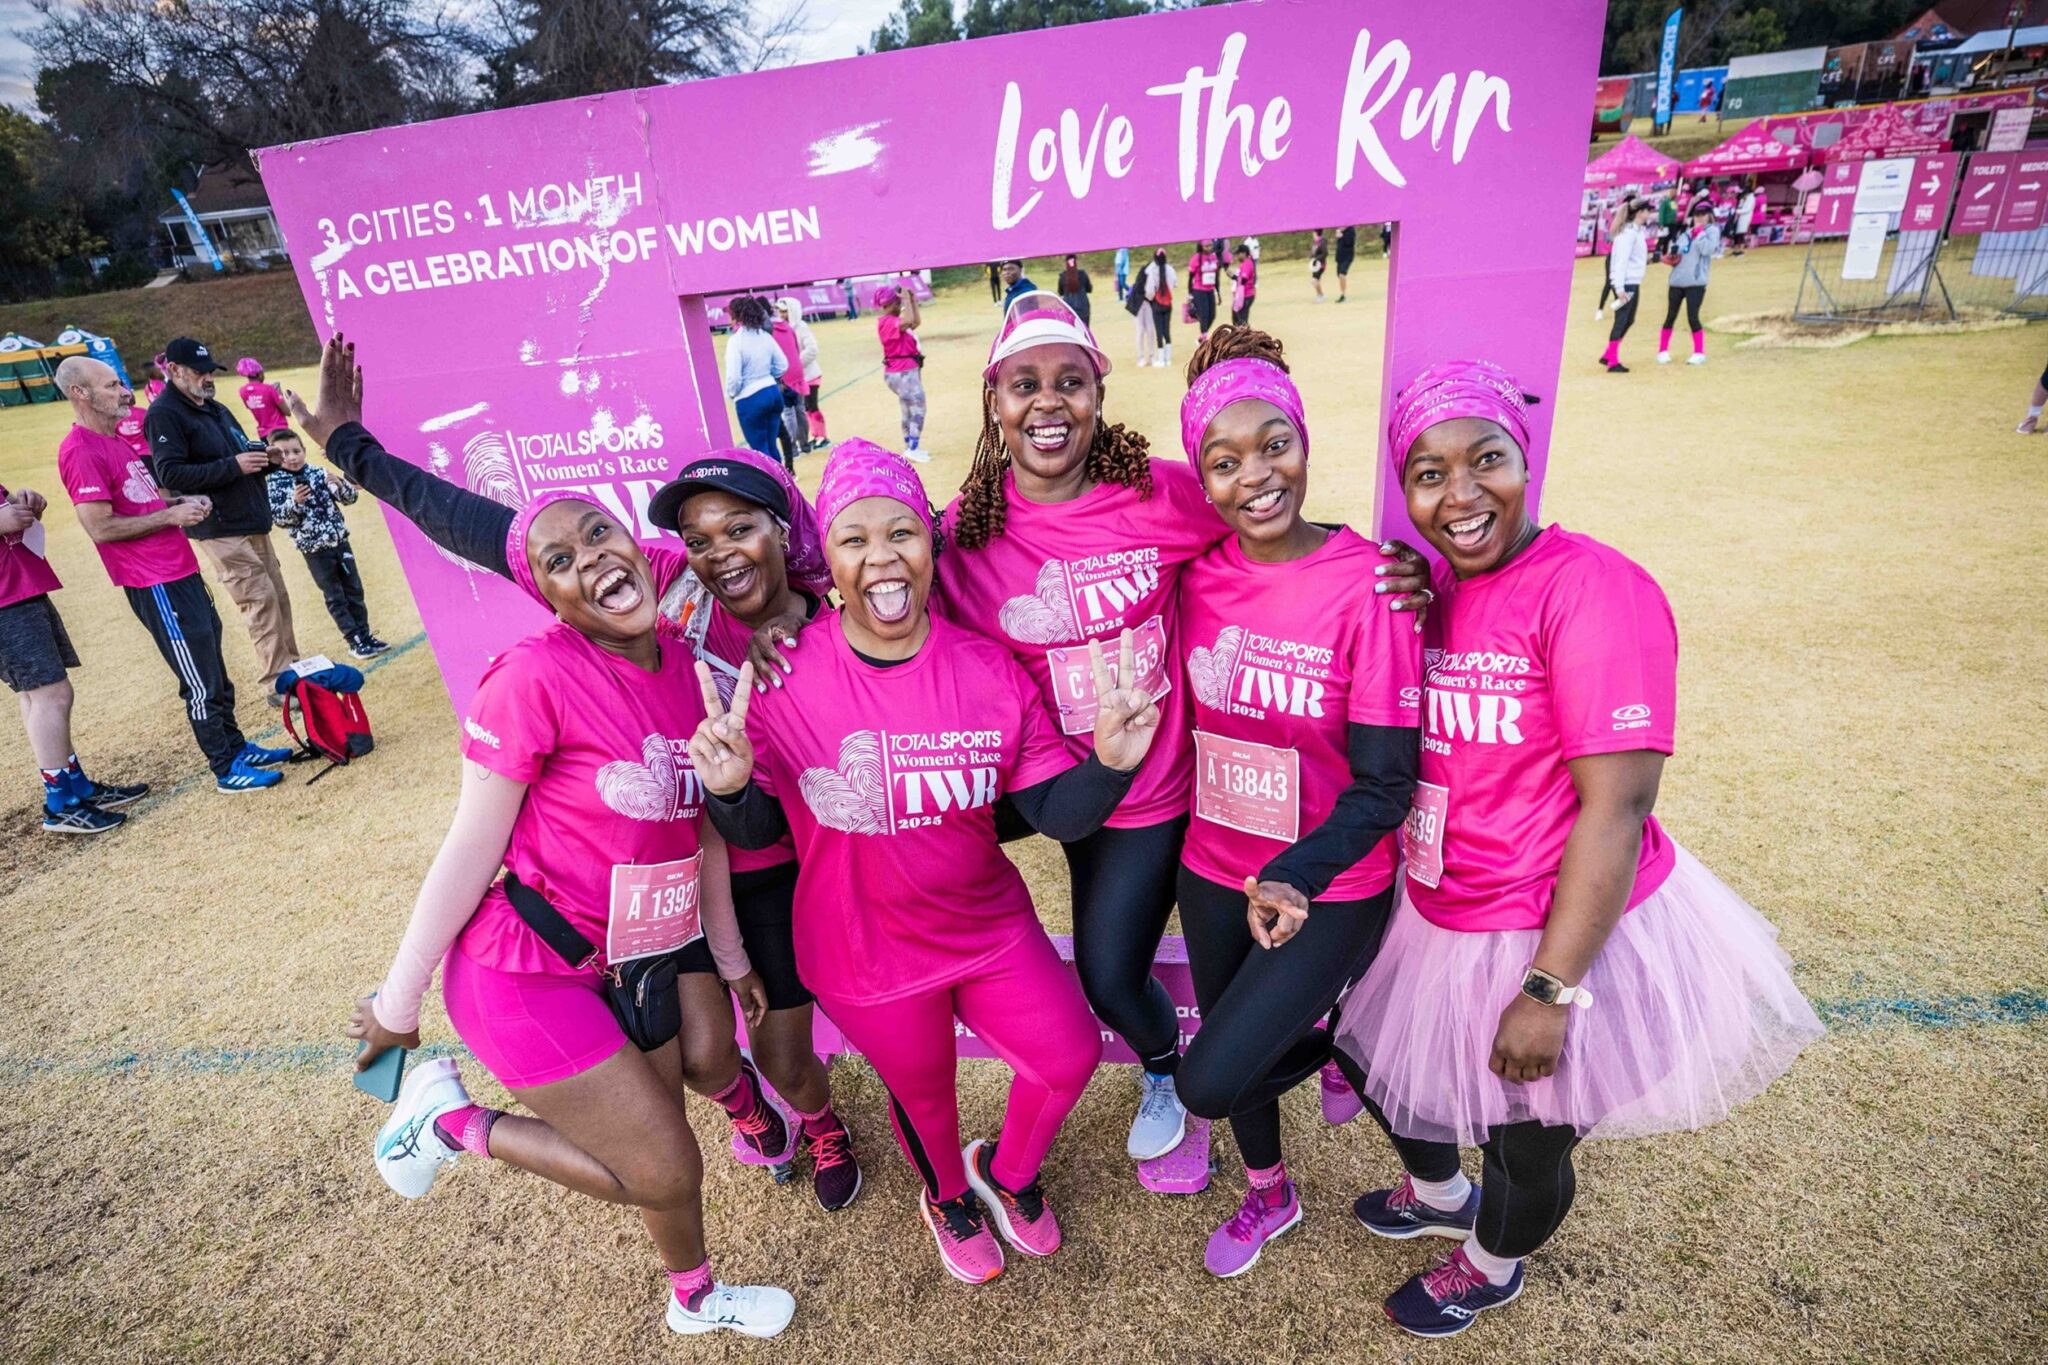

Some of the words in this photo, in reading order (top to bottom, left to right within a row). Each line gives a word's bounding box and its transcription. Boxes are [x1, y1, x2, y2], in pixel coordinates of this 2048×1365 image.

[992, 81, 1136, 230] Love
[1335, 27, 1512, 191] Run
[1973, 165, 2006, 175] TOILETS
[1823, 185, 1856, 195] VENDORS
[318, 217, 339, 248] 3
[348, 200, 455, 246] CITIES
[478, 193, 502, 227] 1
[508, 172, 642, 223] MONTH
[337, 269, 362, 300] A
[364, 233, 606, 295] CELEBRATION
[608, 226, 658, 264] OF
[668, 206, 822, 257] WOMEN
[517, 422, 665, 460] TOTALSPORTS
[525, 457, 616, 484] Women's
[618, 455, 669, 476] Race
[1070, 547, 1159, 572] TOTALSPORTS
[1072, 565, 1132, 584] Women's
[1085, 616, 1124, 635] 2025
[1246, 633, 1335, 665] TOTALSPORTS
[1243, 651, 1293, 673] Women's
[1295, 662, 1329, 679] Race
[1068, 671, 1085, 700] C
[1237, 665, 1326, 719] TWR
[1480, 674, 1527, 691] Race
[1231, 702, 1265, 721] 2025
[1424, 686, 1525, 745] TWR
[1612, 719, 1652, 731] CHERY
[889, 730, 1002, 751] TOTALSPORTS
[1424, 736, 1452, 757] 2025
[892, 751, 967, 768] Women's
[970, 750, 1001, 763] Race
[893, 767, 998, 815] TWR
[1207, 757, 1217, 786] A
[1221, 762, 1288, 802] 13843
[676, 808, 699, 819] 2025
[898, 815, 943, 830] 2025
[626, 891, 641, 920] A
